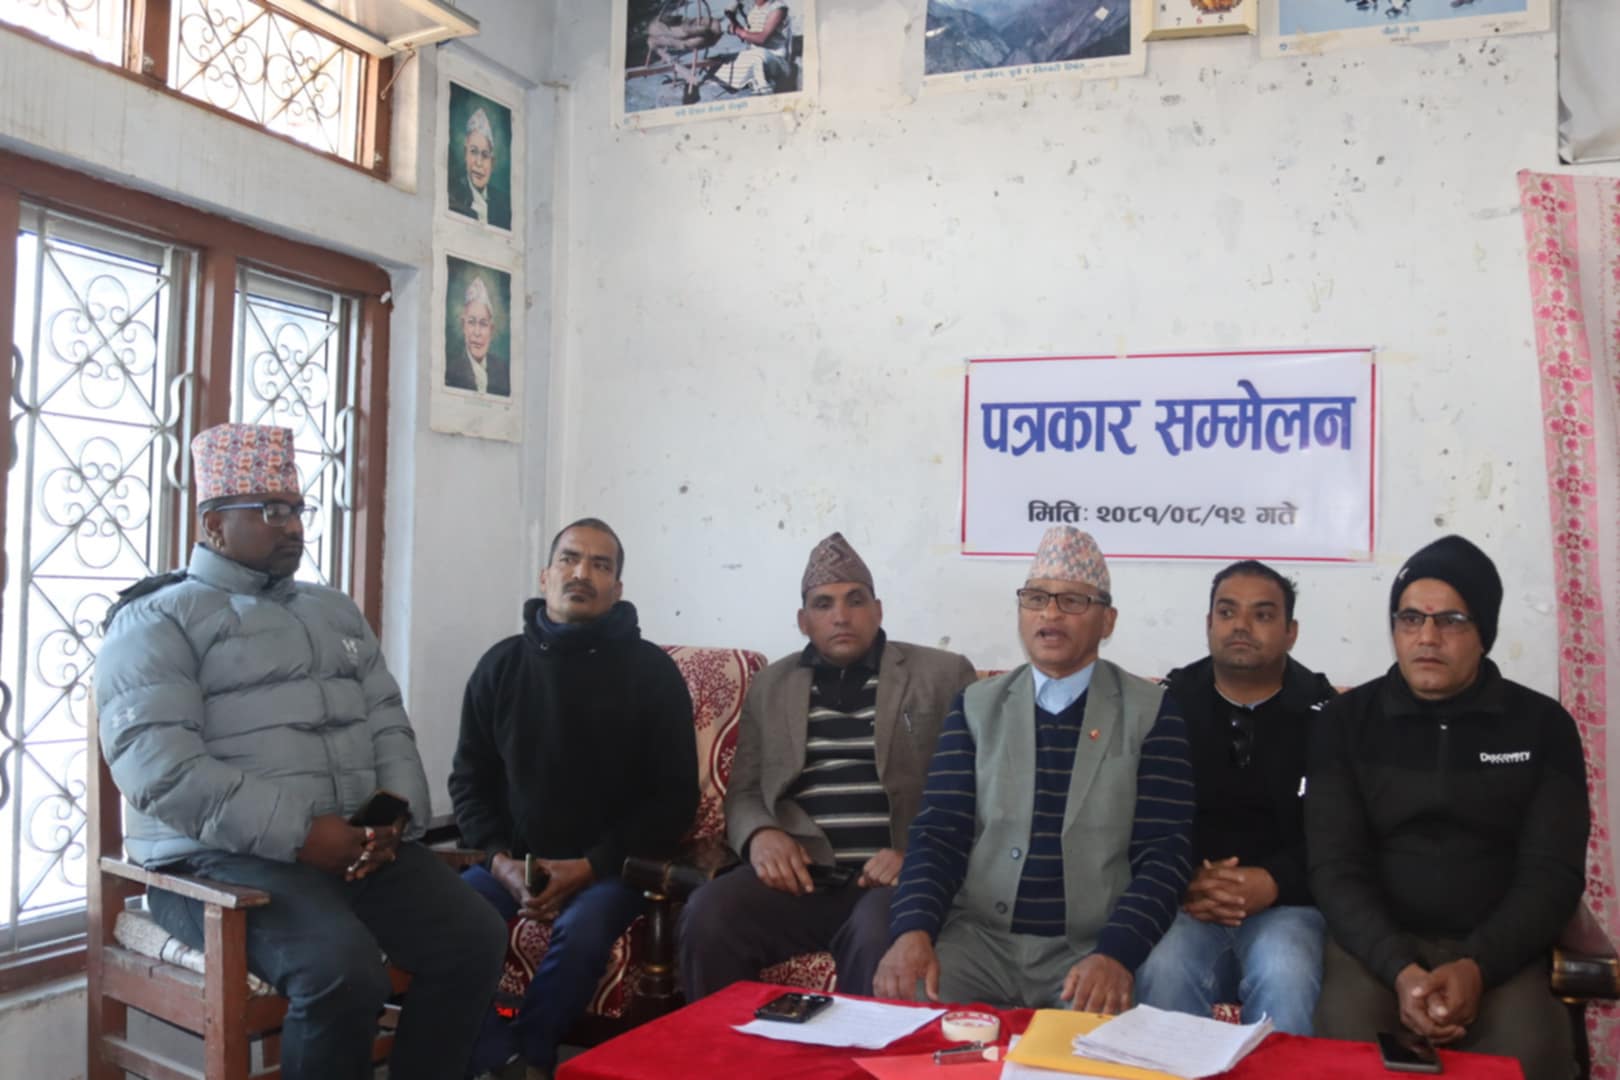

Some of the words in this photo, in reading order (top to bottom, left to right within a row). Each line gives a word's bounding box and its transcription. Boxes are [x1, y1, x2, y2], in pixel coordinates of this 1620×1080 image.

[981, 399, 1142, 457] पत्रकार
[1154, 378, 1358, 457] सम्मेलन
[1096, 503, 1246, 527] २०८१/०८/१२
[1256, 501, 1299, 526] गते
